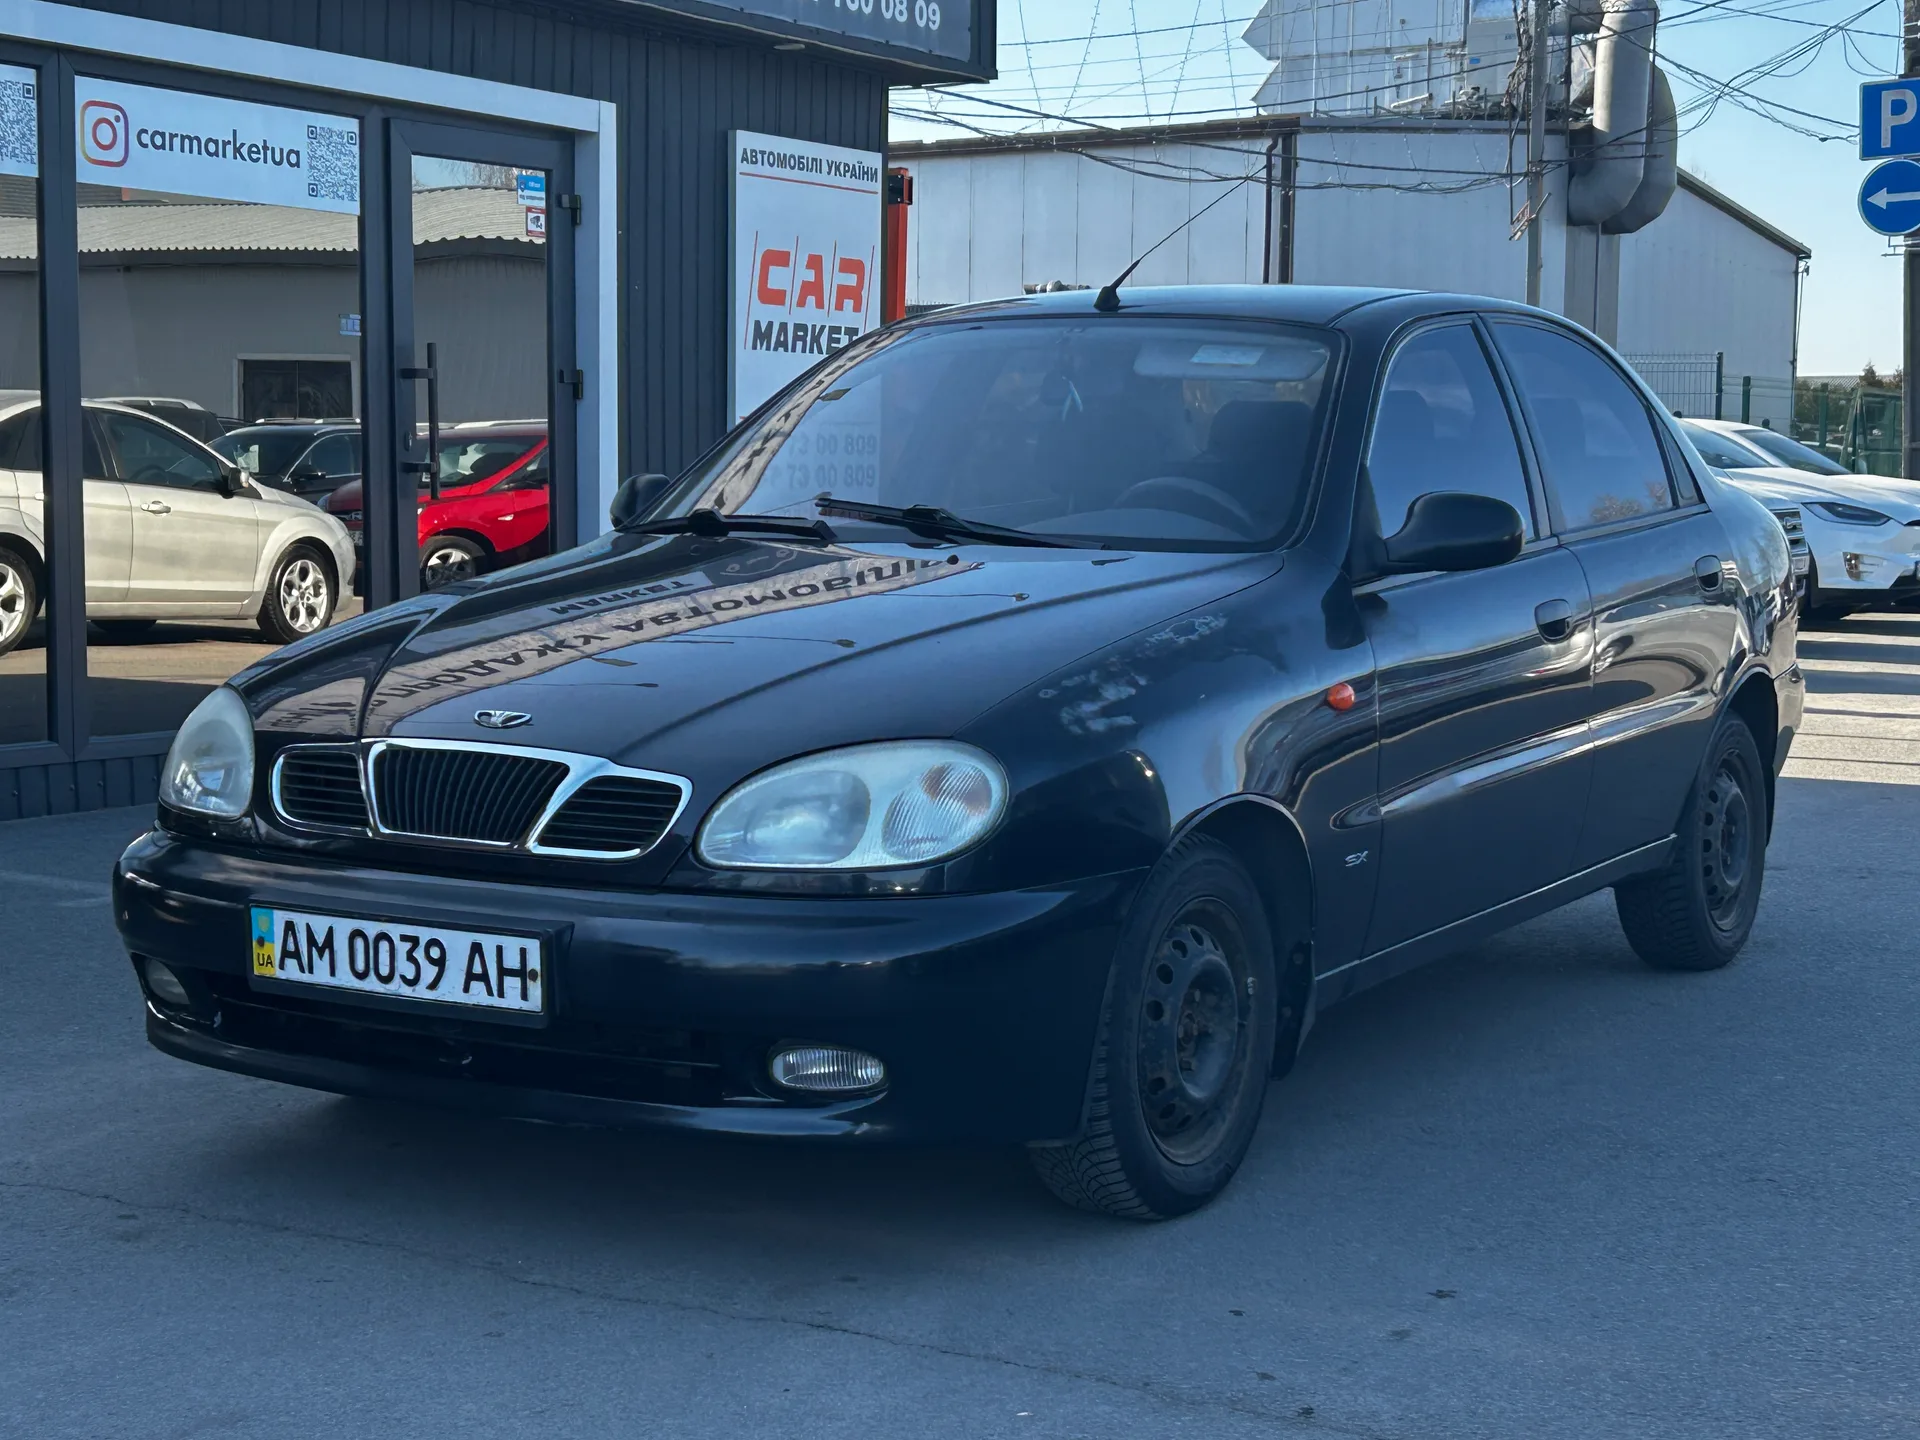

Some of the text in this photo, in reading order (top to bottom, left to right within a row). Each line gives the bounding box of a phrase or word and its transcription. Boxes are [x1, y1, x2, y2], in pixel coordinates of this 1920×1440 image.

[880, 0, 908, 22] 08
[914, 0, 941, 30] 09
[1881, 88, 1918, 148] P
[136, 128, 301, 169] carmarketua
[740, 147, 878, 183] АВТОМОБІЛІ УКРАЇНИ
[757, 248, 866, 313] CAR
[751, 319, 860, 355] MARKET
[257, 952, 274, 968] UA
[278, 919, 529, 1002] AM 0039 AH
